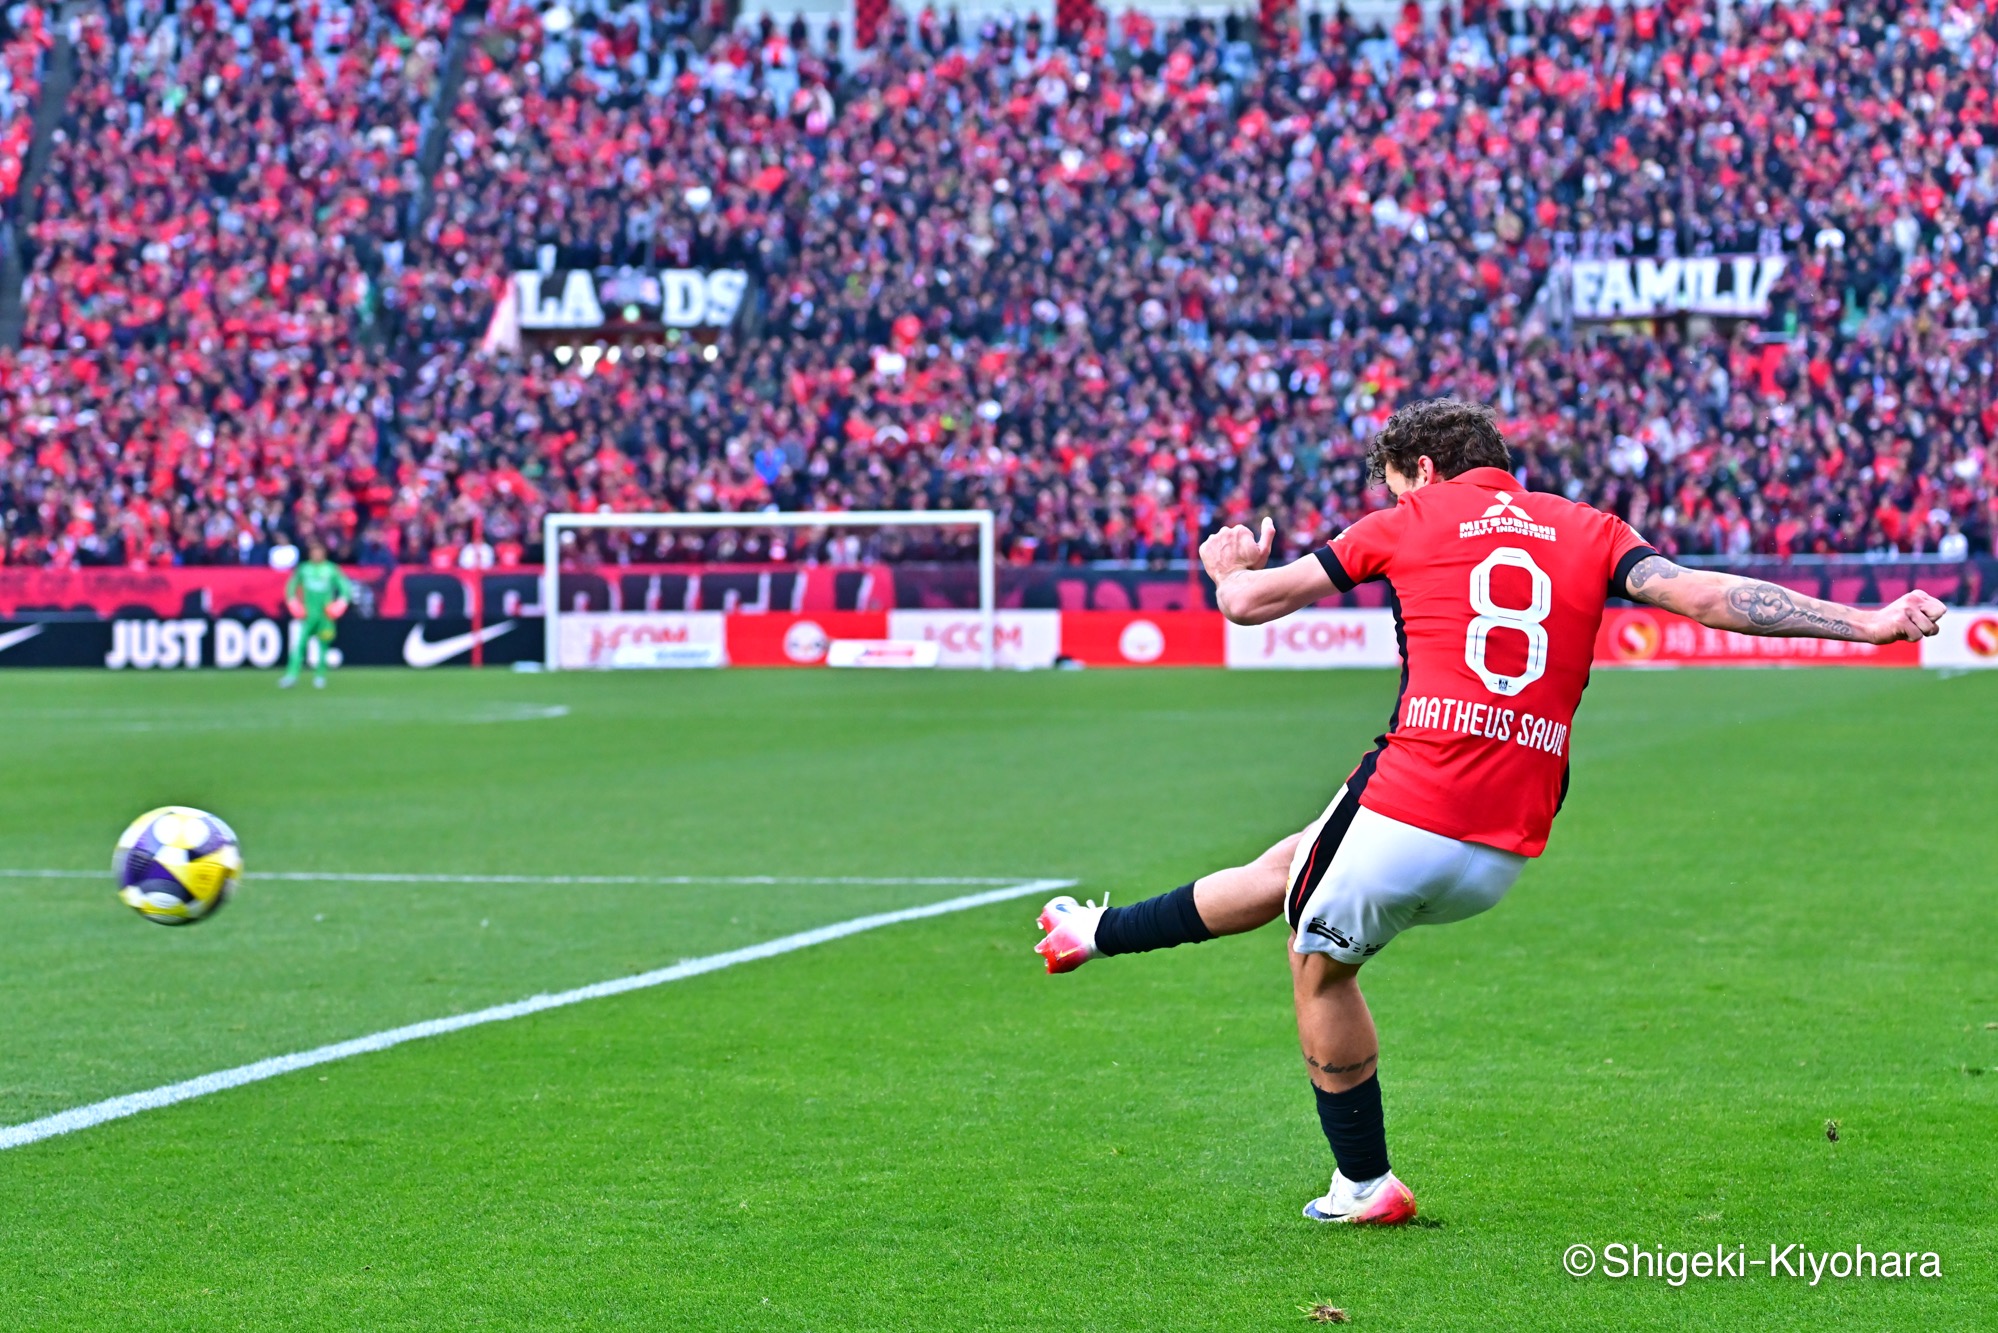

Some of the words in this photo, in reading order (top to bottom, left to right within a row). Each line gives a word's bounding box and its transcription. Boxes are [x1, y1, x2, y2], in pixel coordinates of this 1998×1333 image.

[514, 268, 749, 328] LADS
[1459, 516, 1556, 536] MITSUBISHI
[1459, 527, 1493, 539] HEAVY
[1496, 525, 1557, 542] INDUSTRIES
[105, 619, 208, 669] JUST
[214, 619, 283, 669] DO
[1465, 547, 1551, 697] 8
[1405, 696, 1514, 742] MATHEUS
